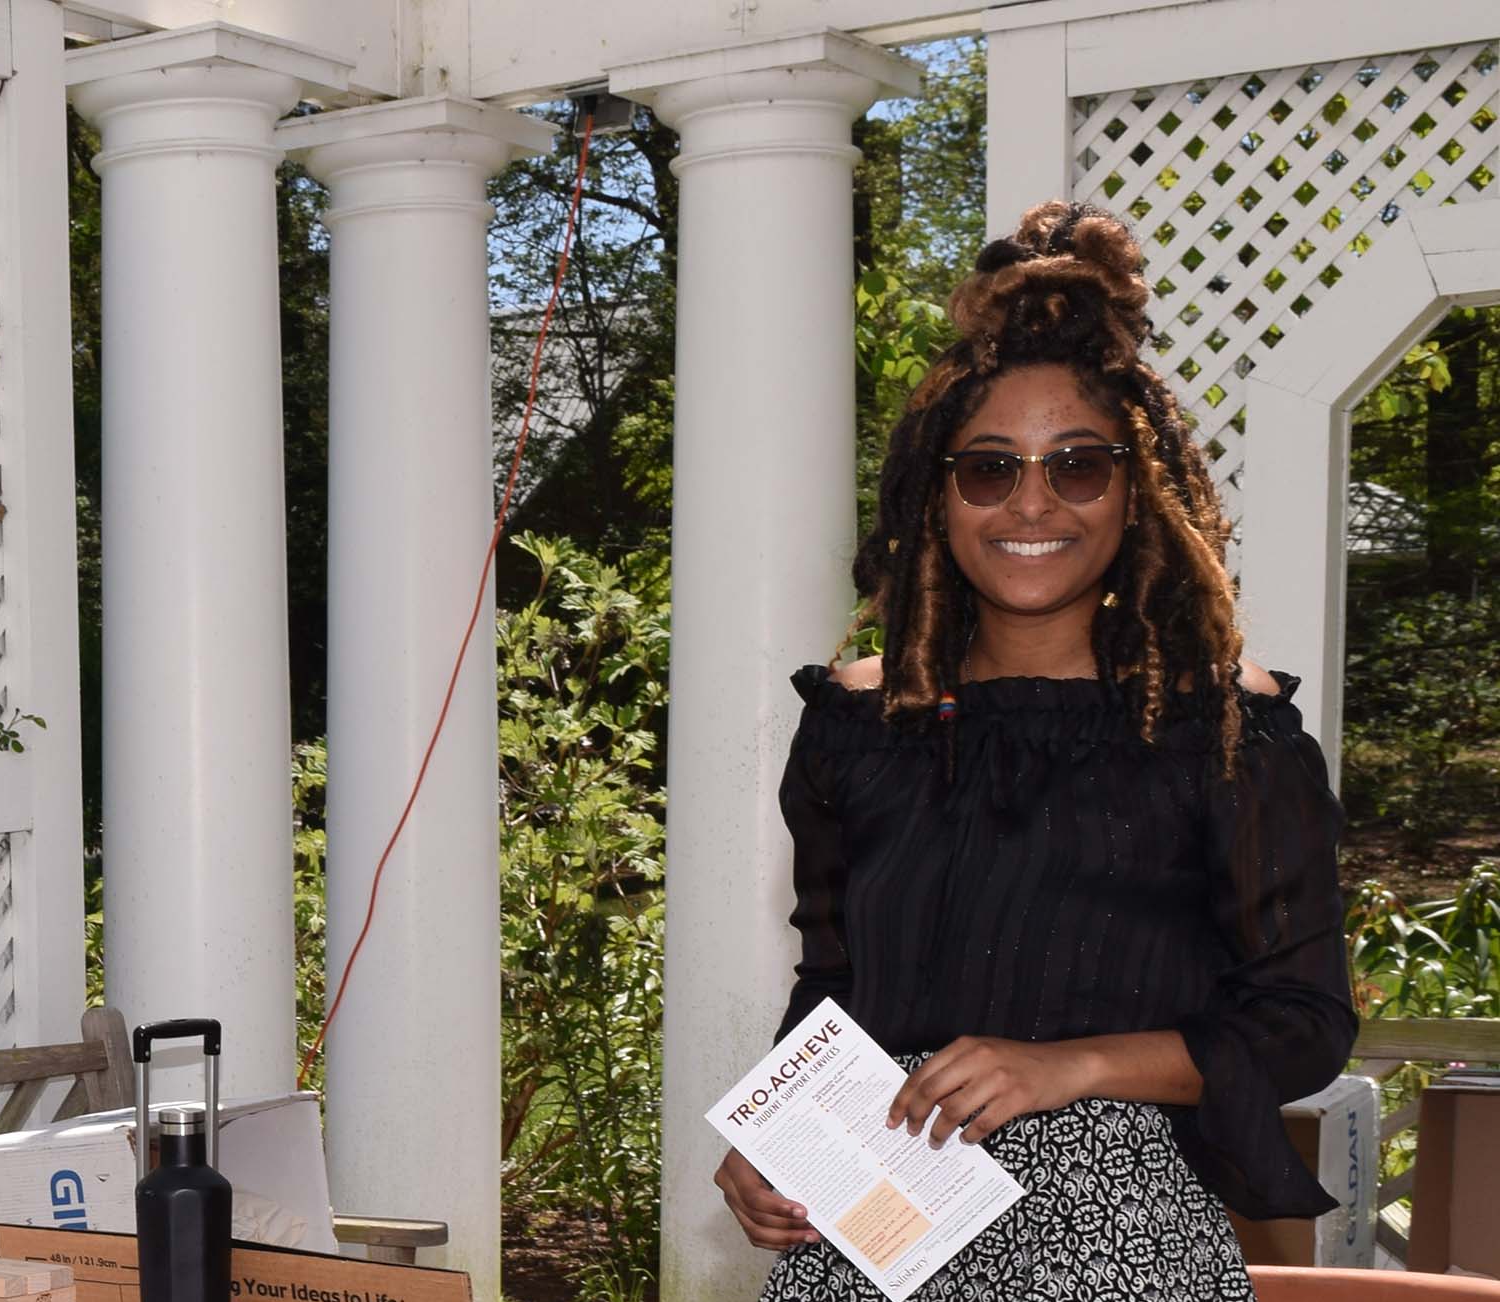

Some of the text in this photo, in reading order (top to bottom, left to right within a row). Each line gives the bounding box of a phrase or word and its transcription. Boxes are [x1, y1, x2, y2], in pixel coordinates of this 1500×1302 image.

[753, 1045, 841, 1128] STUDENT SUPPORT SERVICES
[243, 1278, 287, 1298] Your
